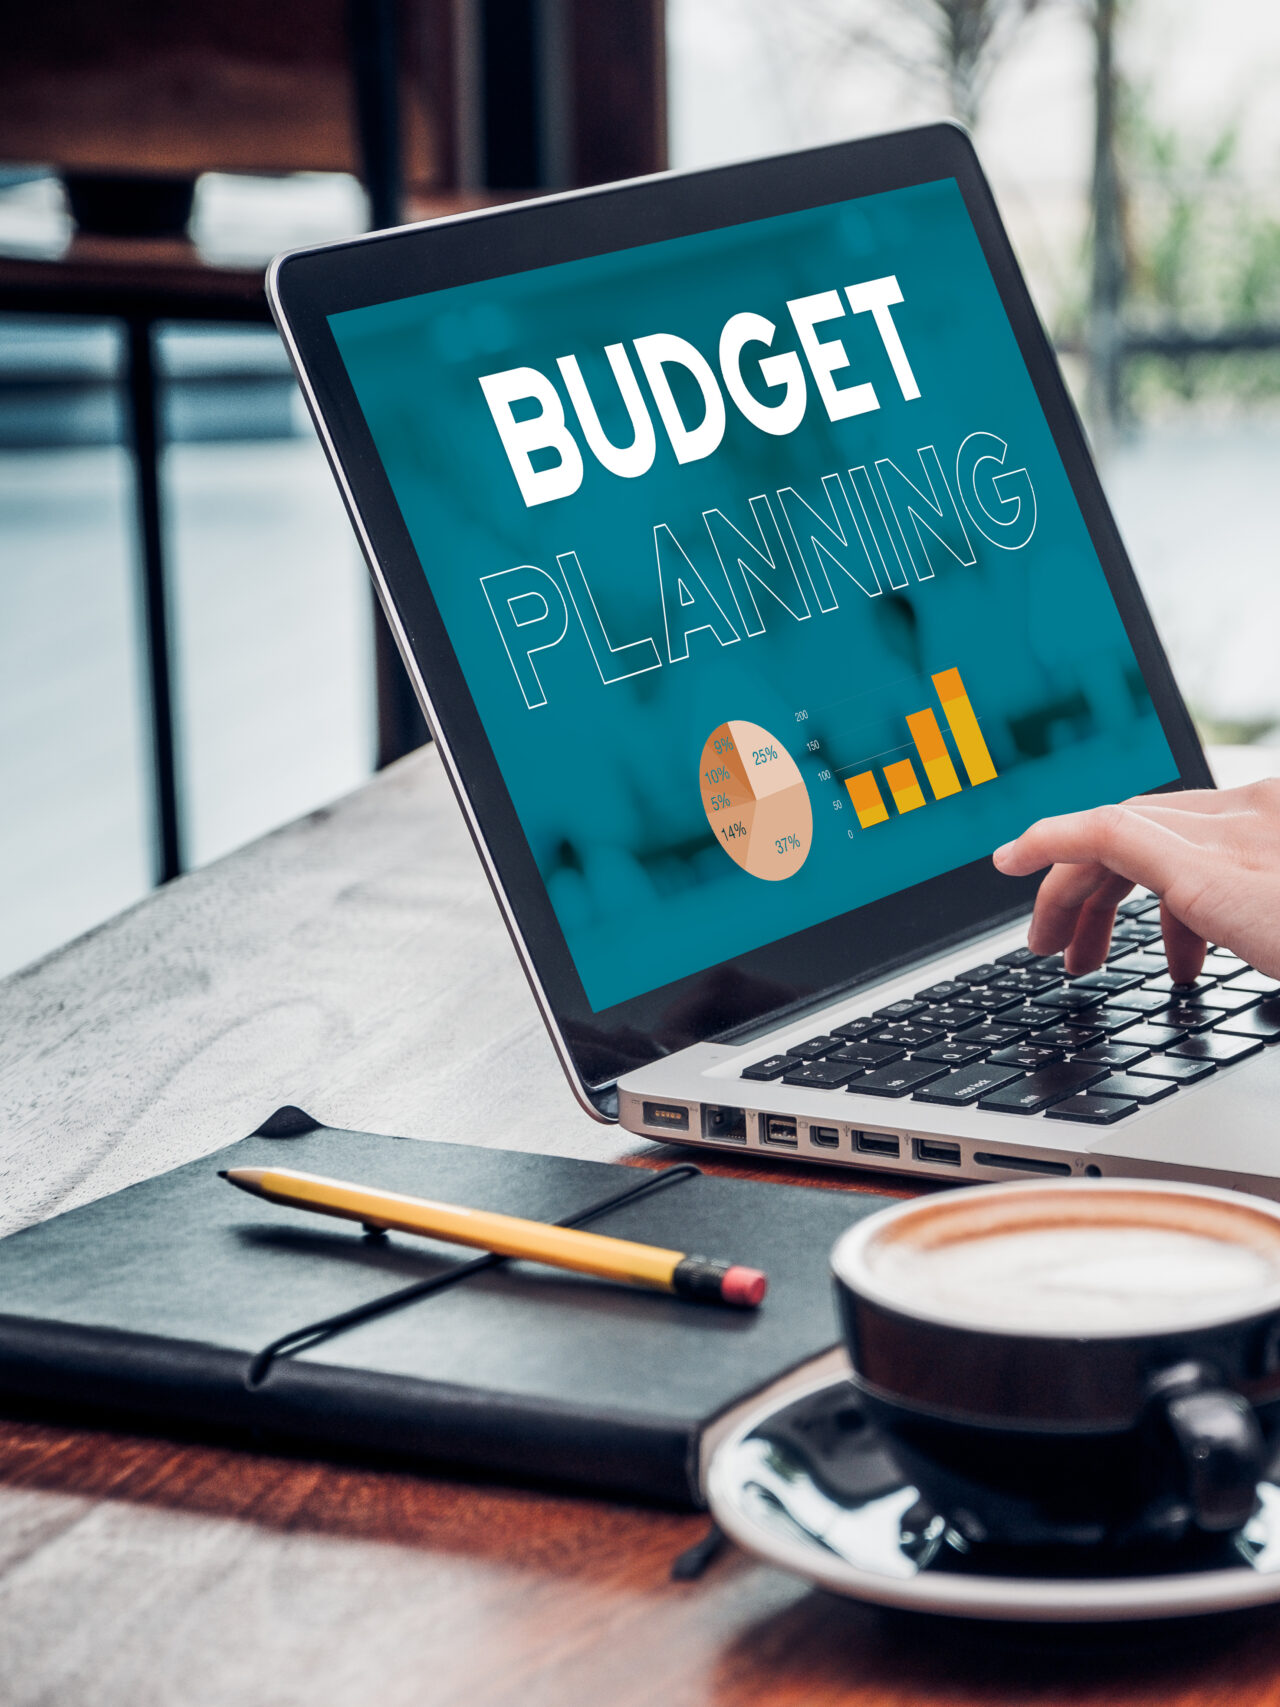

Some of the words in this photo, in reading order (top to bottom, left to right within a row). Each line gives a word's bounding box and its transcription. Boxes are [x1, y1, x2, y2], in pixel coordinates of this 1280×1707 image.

[478, 275, 921, 507] BUDGET
[480, 431, 1037, 709] PLANNING
[795, 710, 808, 722] 200
[714, 736, 733, 755] 9%
[752, 745, 778, 766] 25%
[806, 739, 820, 752] 150
[704, 765, 730, 786] 10%
[818, 769, 831, 782] 100
[710, 792, 731, 812] 5%
[833, 800, 842, 811] 50
[721, 821, 747, 842] 14%
[848, 830, 854, 839] 0
[775, 833, 801, 855] 37%
